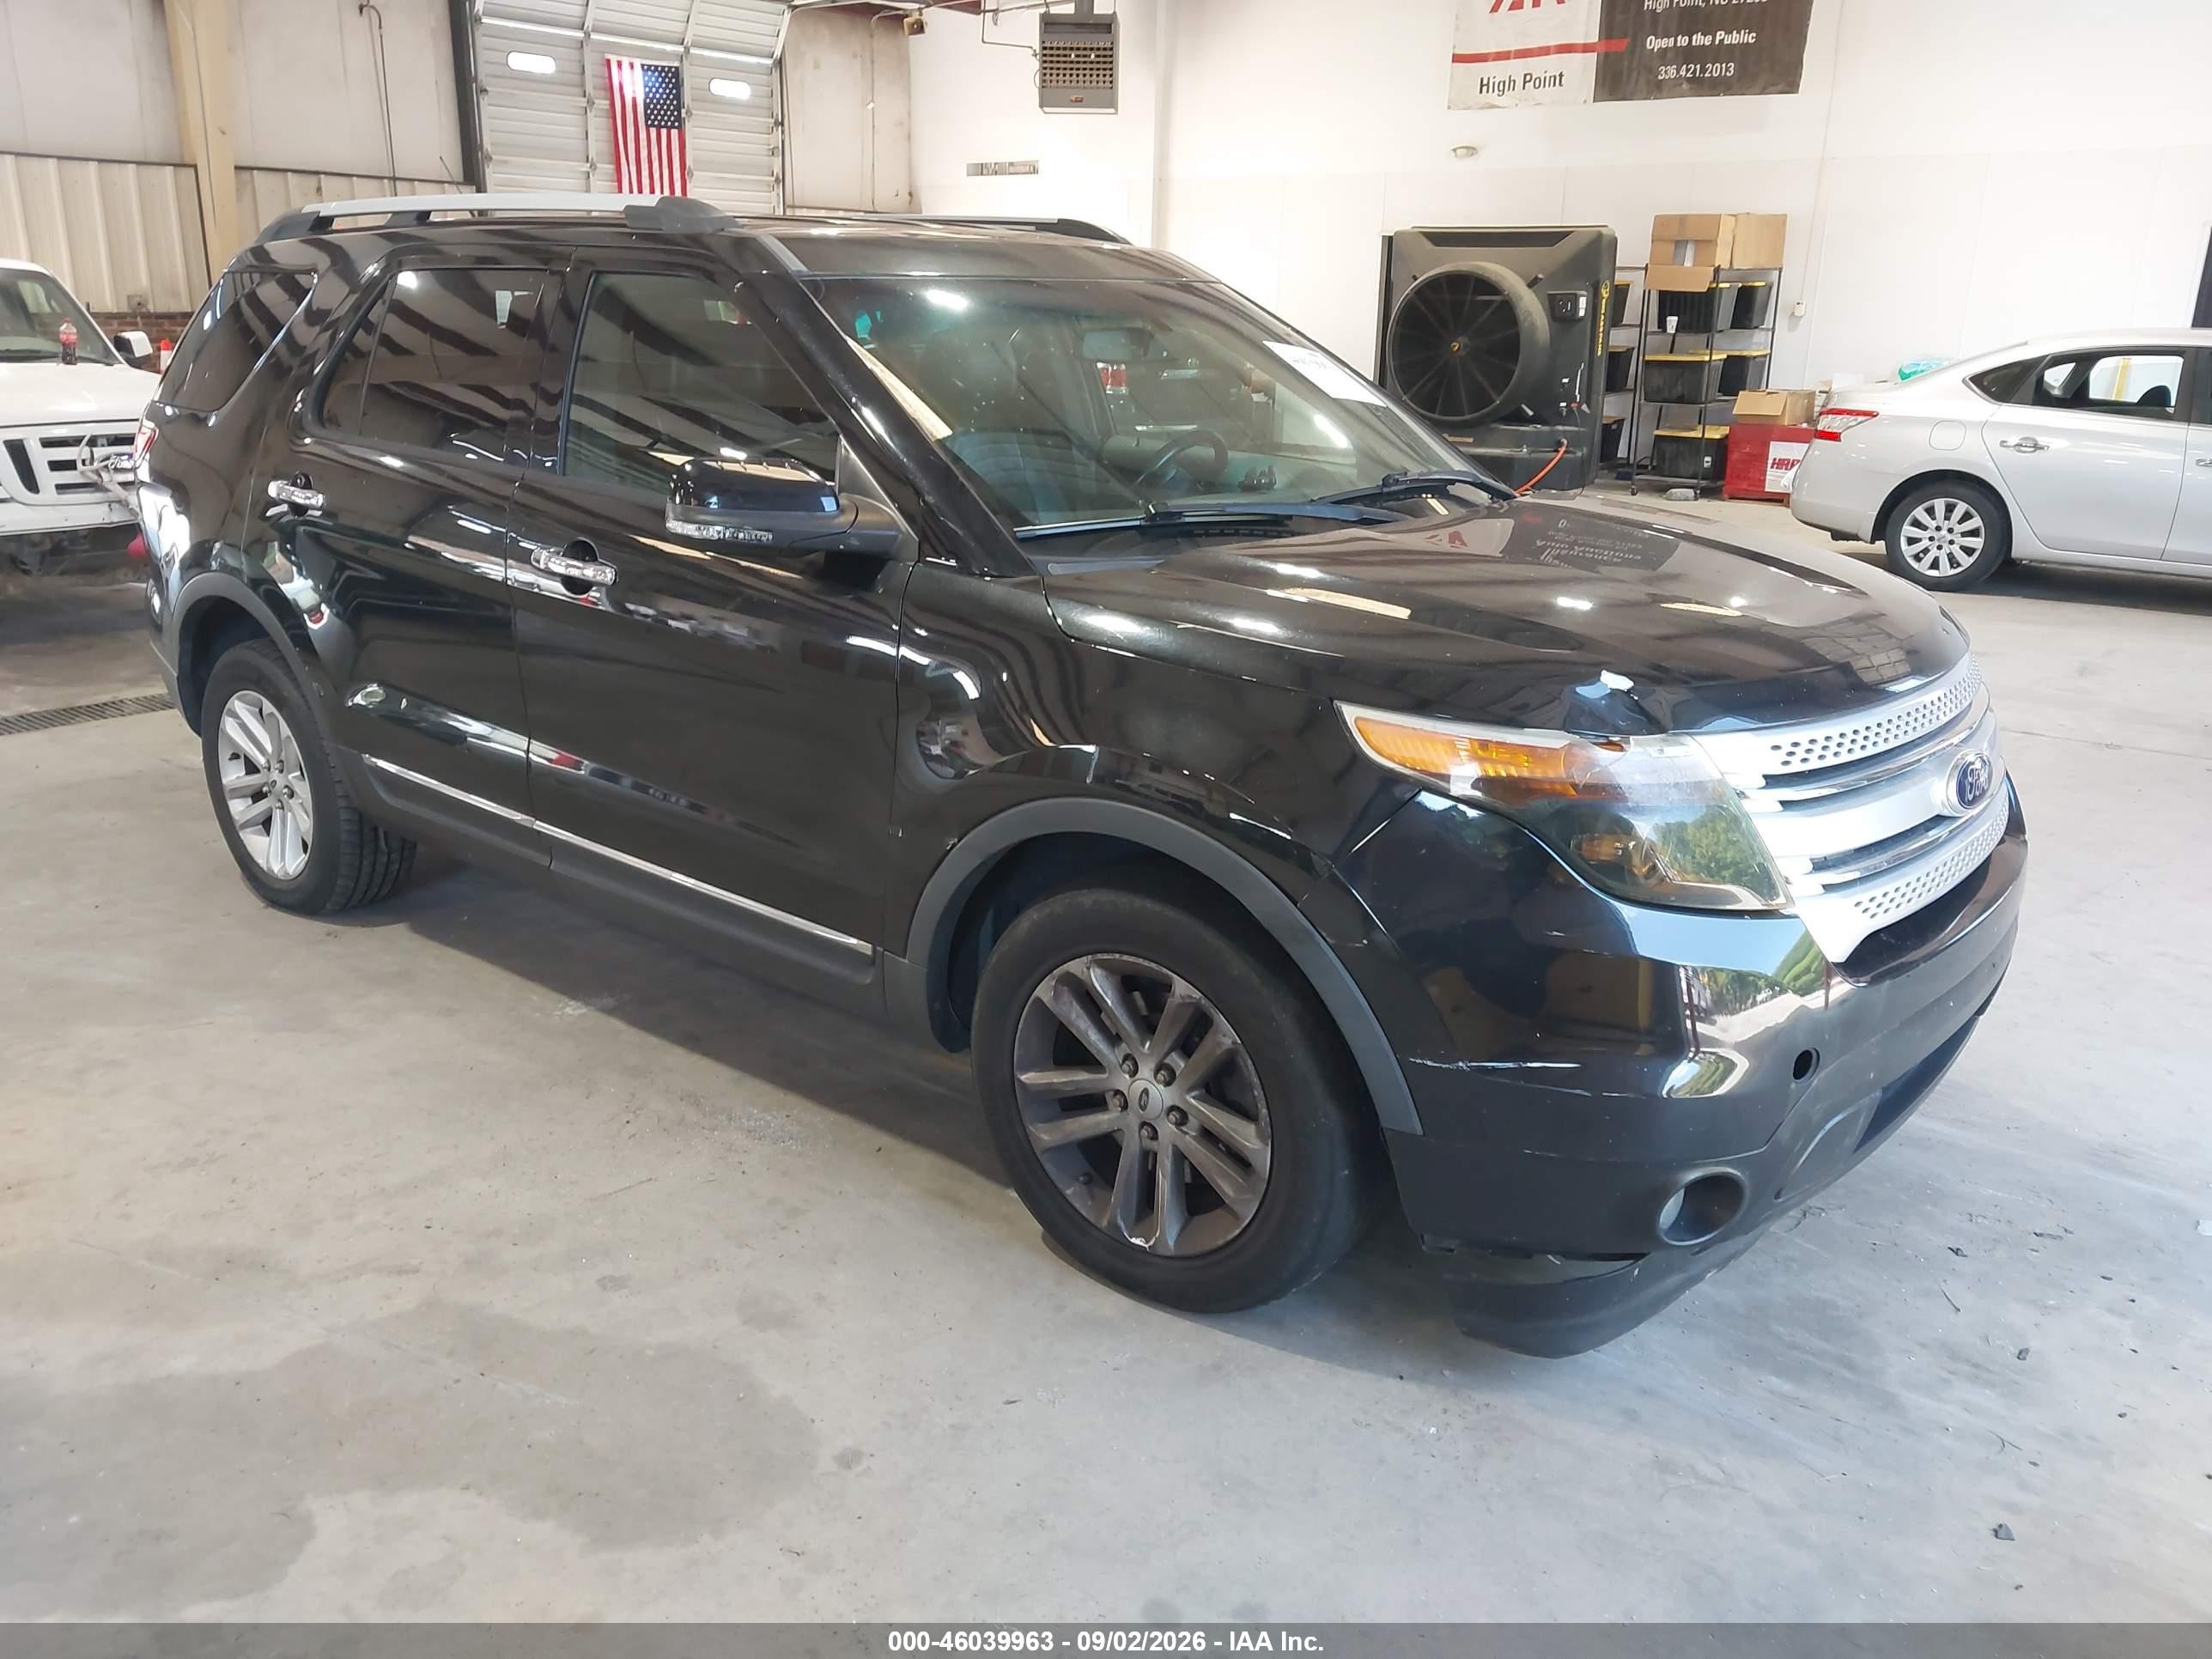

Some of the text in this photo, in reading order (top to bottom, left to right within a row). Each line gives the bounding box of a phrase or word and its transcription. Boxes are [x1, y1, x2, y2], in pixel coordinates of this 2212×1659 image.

[1646, 29, 1757, 52] Open to the Public
[1658, 63, 1735, 80] 336.421.2013
[1479, 70, 1565, 97] High Point
